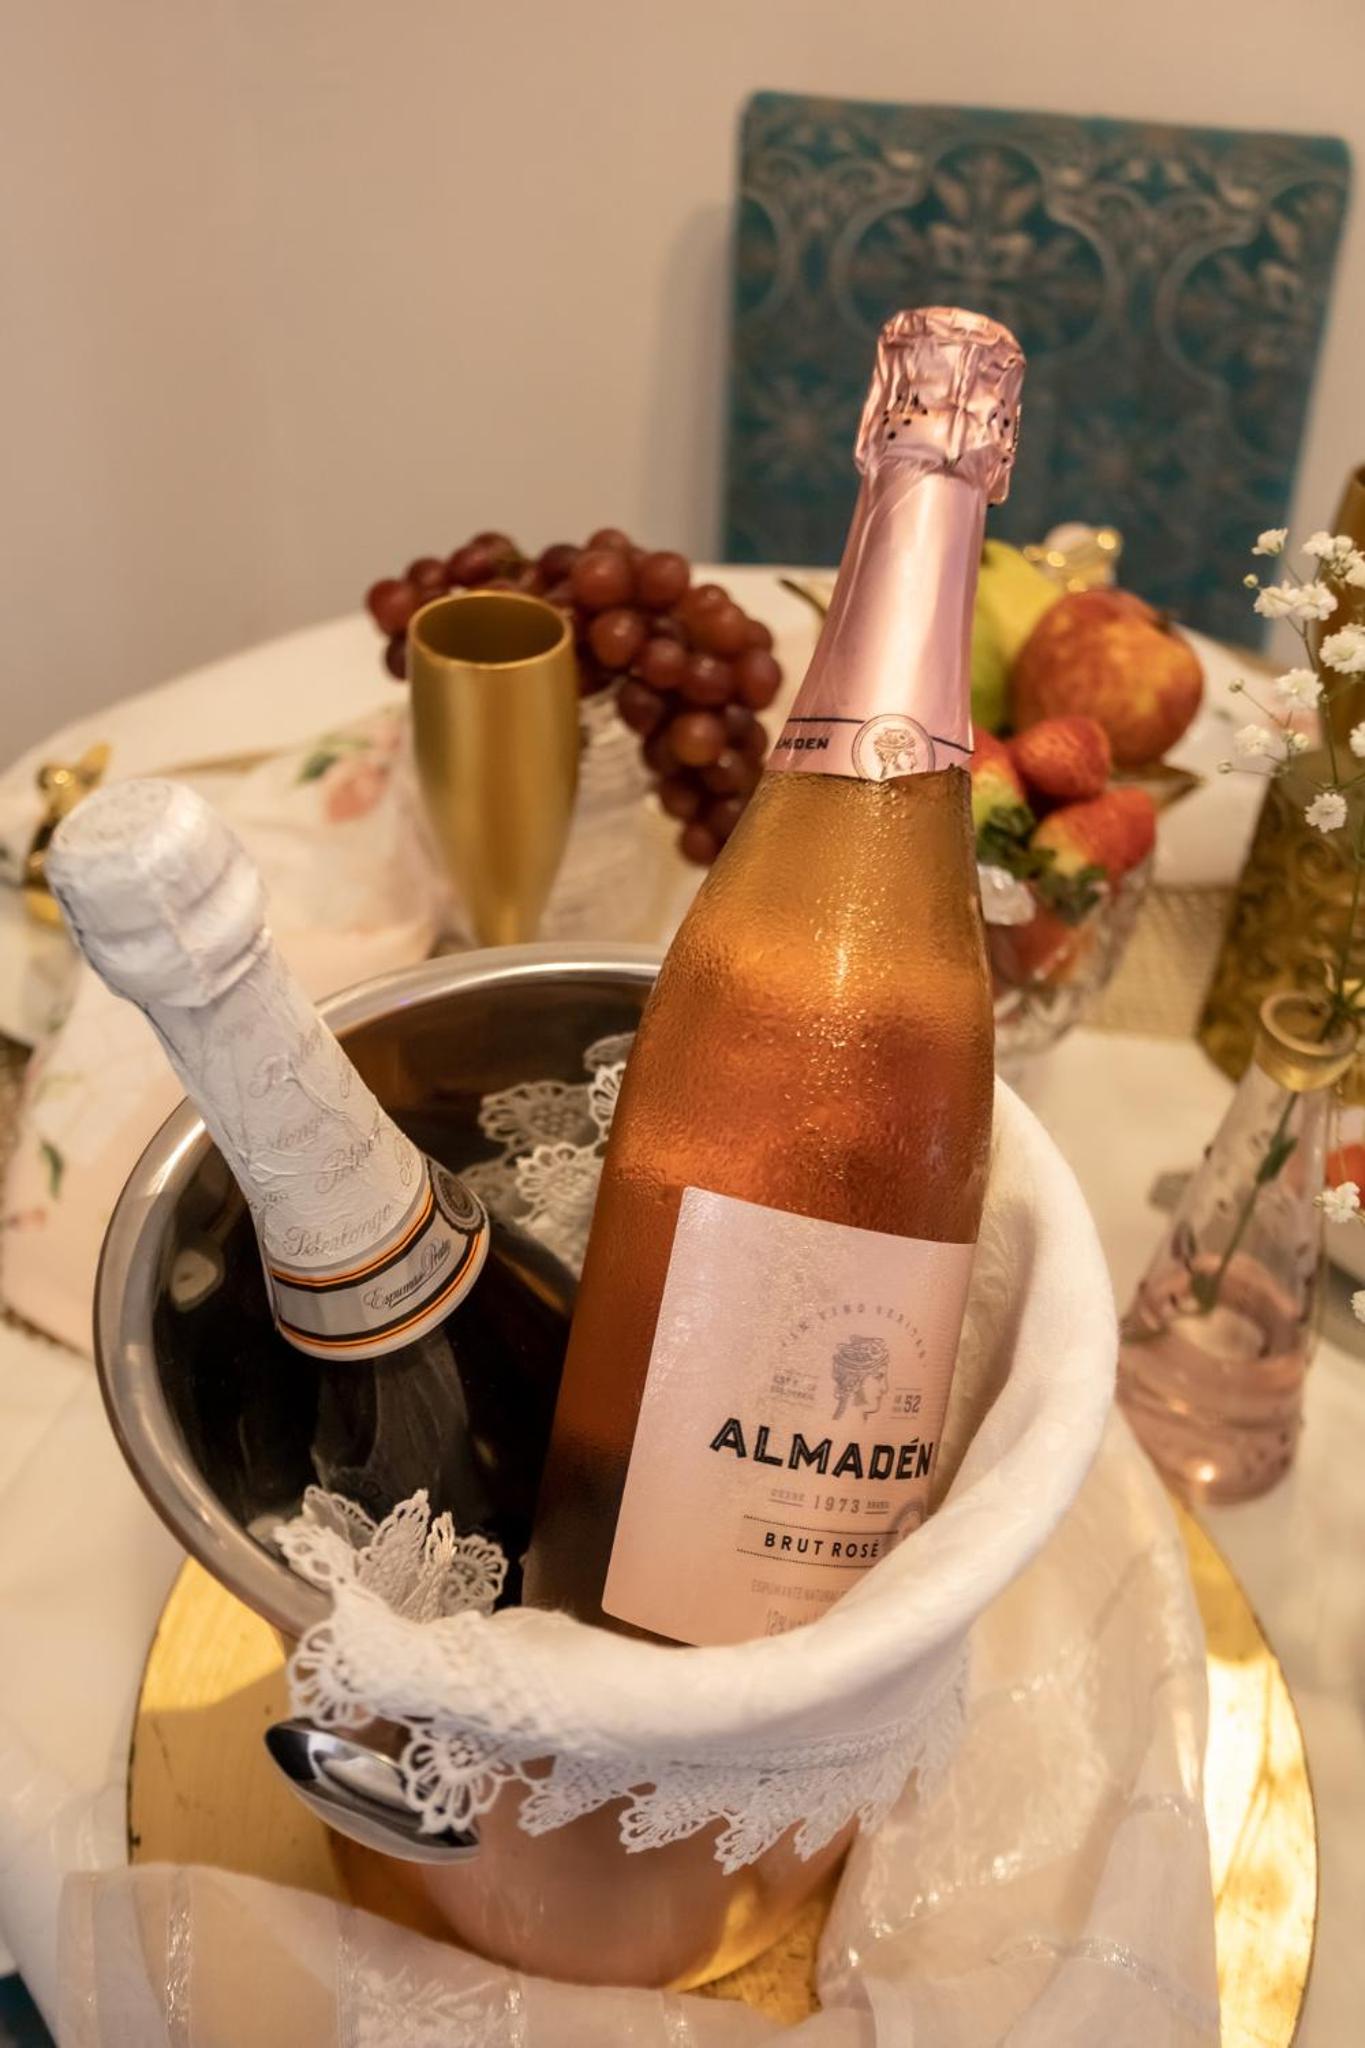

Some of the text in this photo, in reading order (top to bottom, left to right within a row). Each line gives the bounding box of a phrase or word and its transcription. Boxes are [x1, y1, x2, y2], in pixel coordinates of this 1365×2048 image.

[904, 1395, 922, 1413] 52
[709, 1417, 934, 1480] ALMADÉN
[813, 1496, 860, 1514] 1973
[764, 1532, 880, 1558] BRUT ROSÉ
